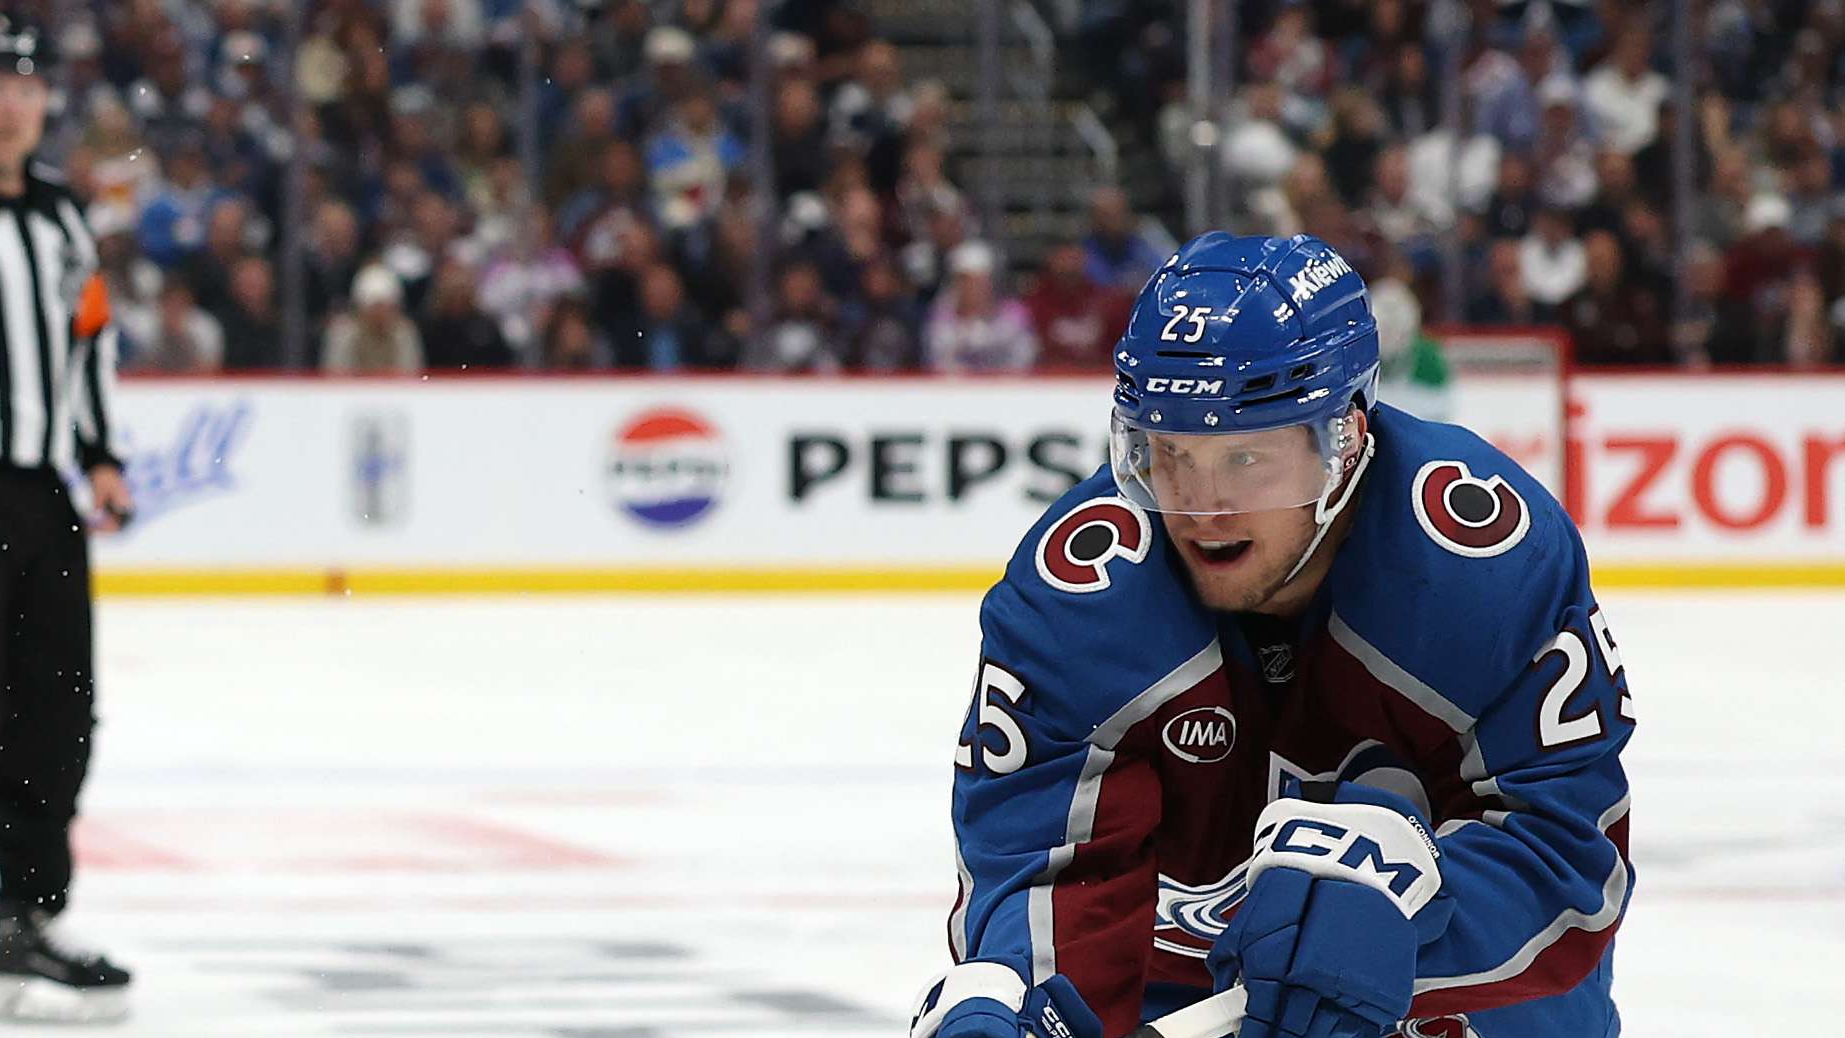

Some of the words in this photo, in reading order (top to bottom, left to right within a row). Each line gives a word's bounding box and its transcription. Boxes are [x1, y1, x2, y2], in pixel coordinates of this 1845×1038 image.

[1160, 304, 1212, 344] 25
[1145, 377, 1225, 395] CCM
[788, 430, 1111, 506] PEPS
[1178, 720, 1228, 747] IMA
[1408, 815, 1440, 859] O'CONNOR
